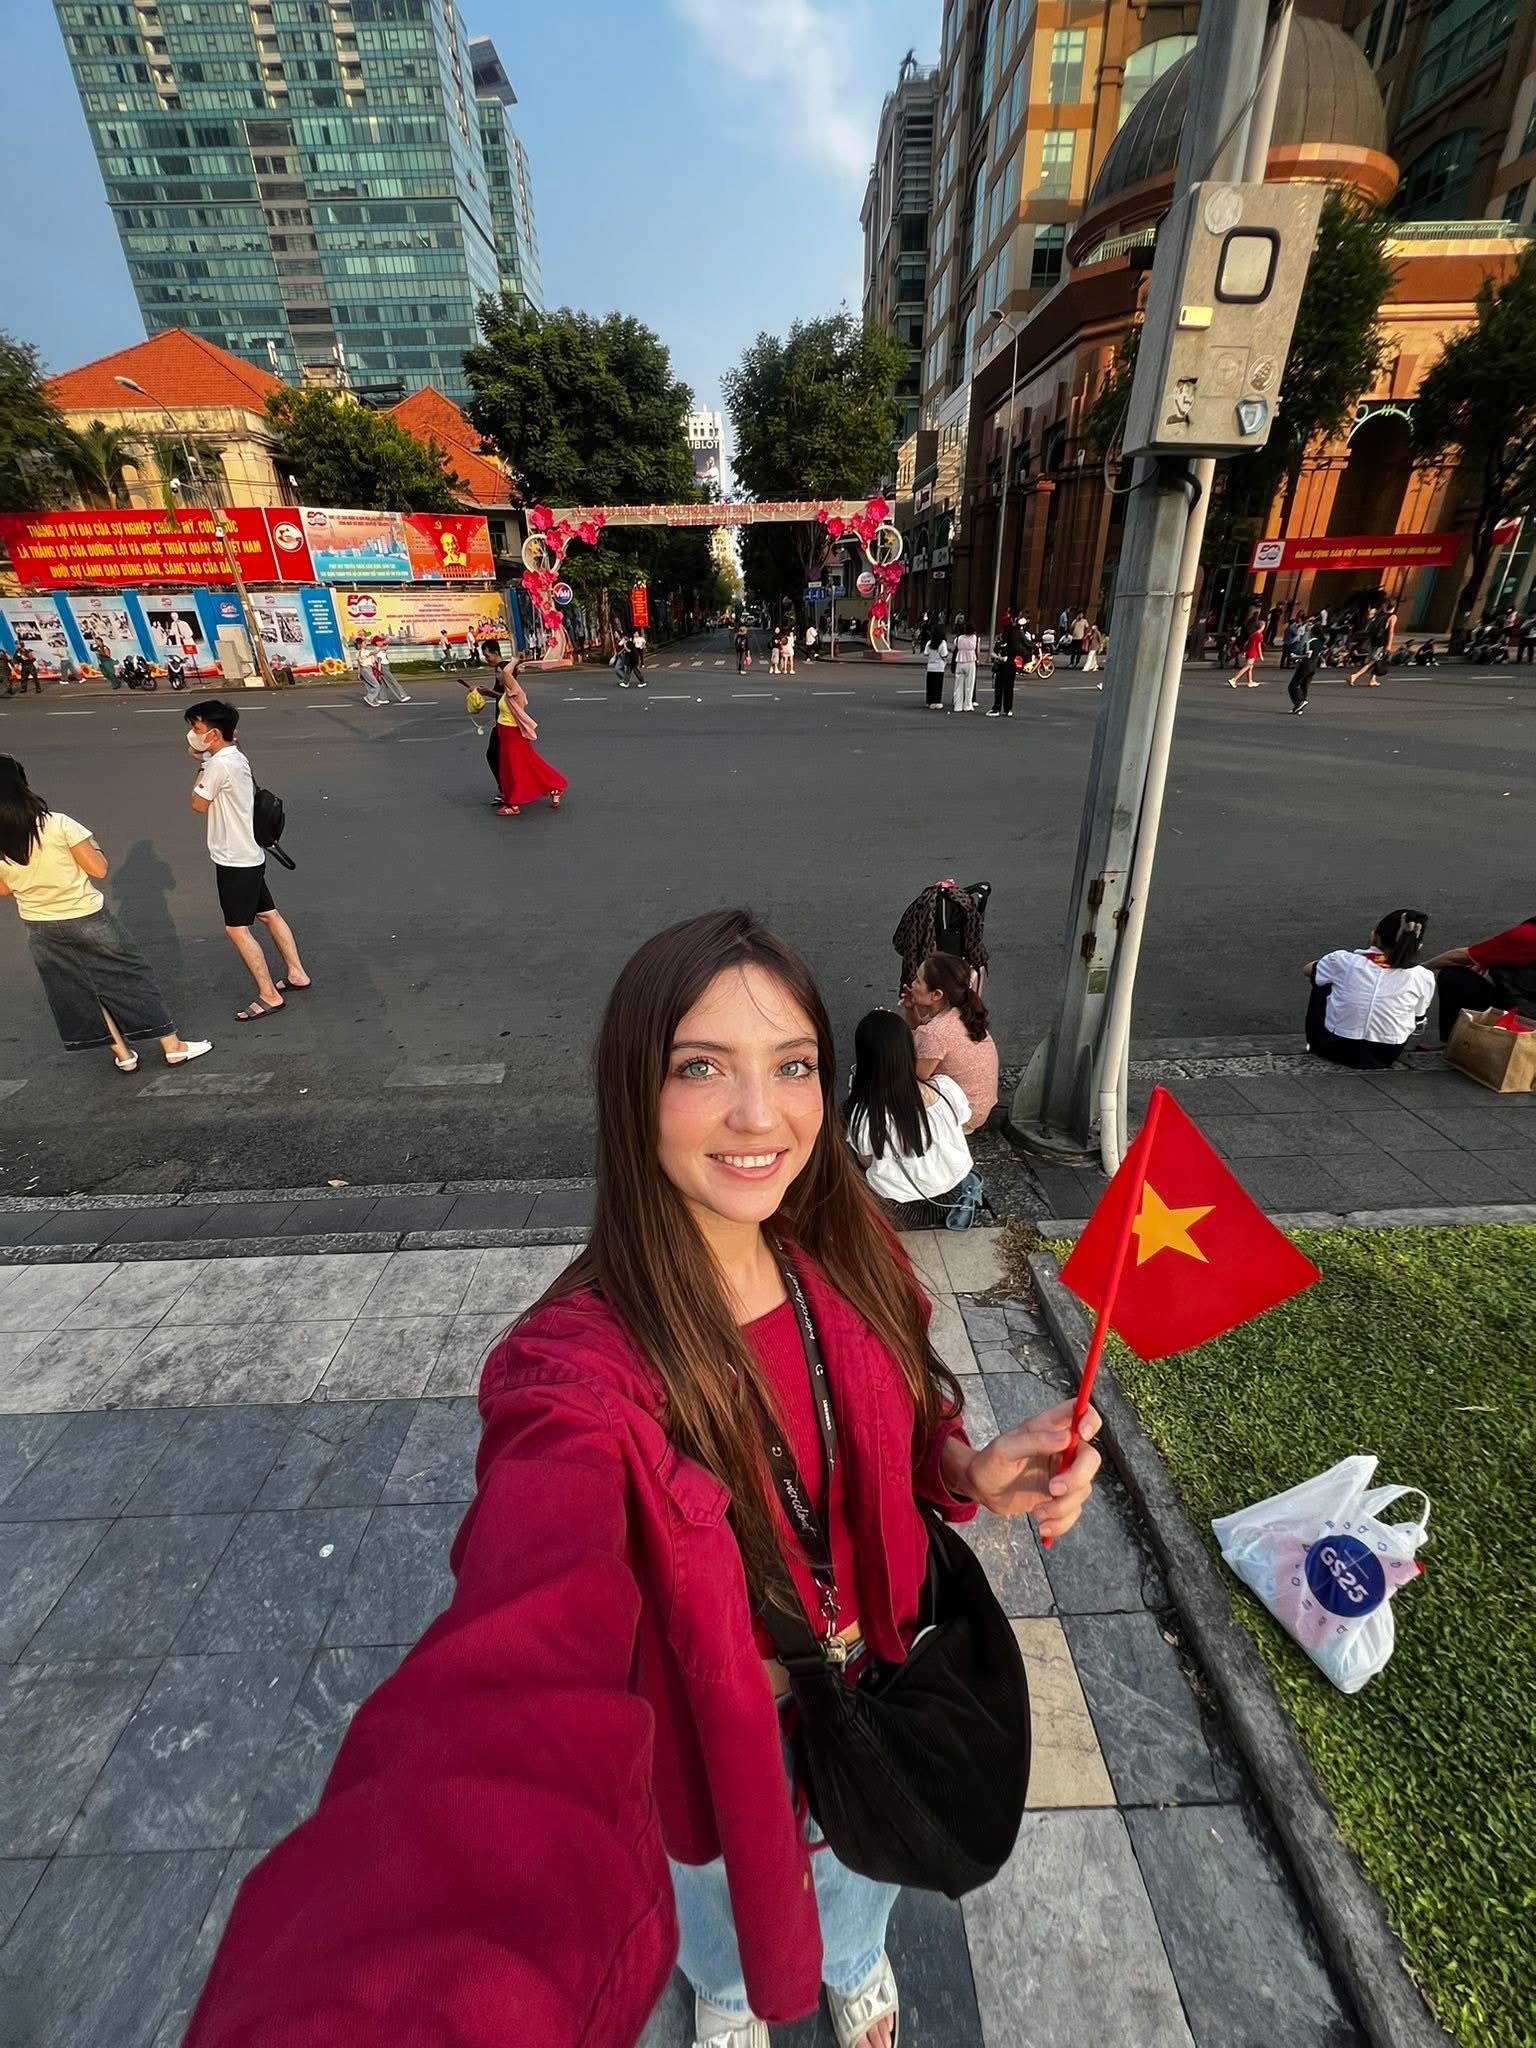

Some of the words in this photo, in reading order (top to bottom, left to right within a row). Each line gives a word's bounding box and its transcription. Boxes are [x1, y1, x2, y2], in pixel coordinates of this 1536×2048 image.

[687, 440, 719, 449] UBLOT
[28, 521, 56, 537] THẮNG
[55, 524, 69, 539] LỢI
[78, 524, 94, 538] ĐẠI
[94, 521, 111, 536] CỦA
[111, 522, 123, 538] SỰ
[123, 521, 152, 538] NGHIỆP
[18, 544, 30, 558] LÀ
[30, 542, 56, 558] THẮNG
[56, 544, 70, 560] LỢI
[70, 541, 87, 557] CỦA
[88, 542, 115, 557] ĐƯỜNG
[116, 540, 128, 556] LỐI
[129, 541, 141, 556] VÀ
[141, 541, 162, 557] NGHỆ
[163, 541, 188, 557] THUẬT
[189, 541, 211, 555] QUÂN
[242, 541, 262, 553] NAM
[50, 564, 70, 578] DƯỚI
[70, 565, 82, 579] SỰ
[104, 565, 120, 579] ĐẠO
[121, 562, 143, 576] ĐÚNG
[164, 561, 186, 575] SÁNG
[187, 563, 202, 577] TẠO
[203, 559, 220, 574] CỦA
[220, 559, 242, 573] ĐẢG
[1319, 1546, 1370, 1604] GS25
